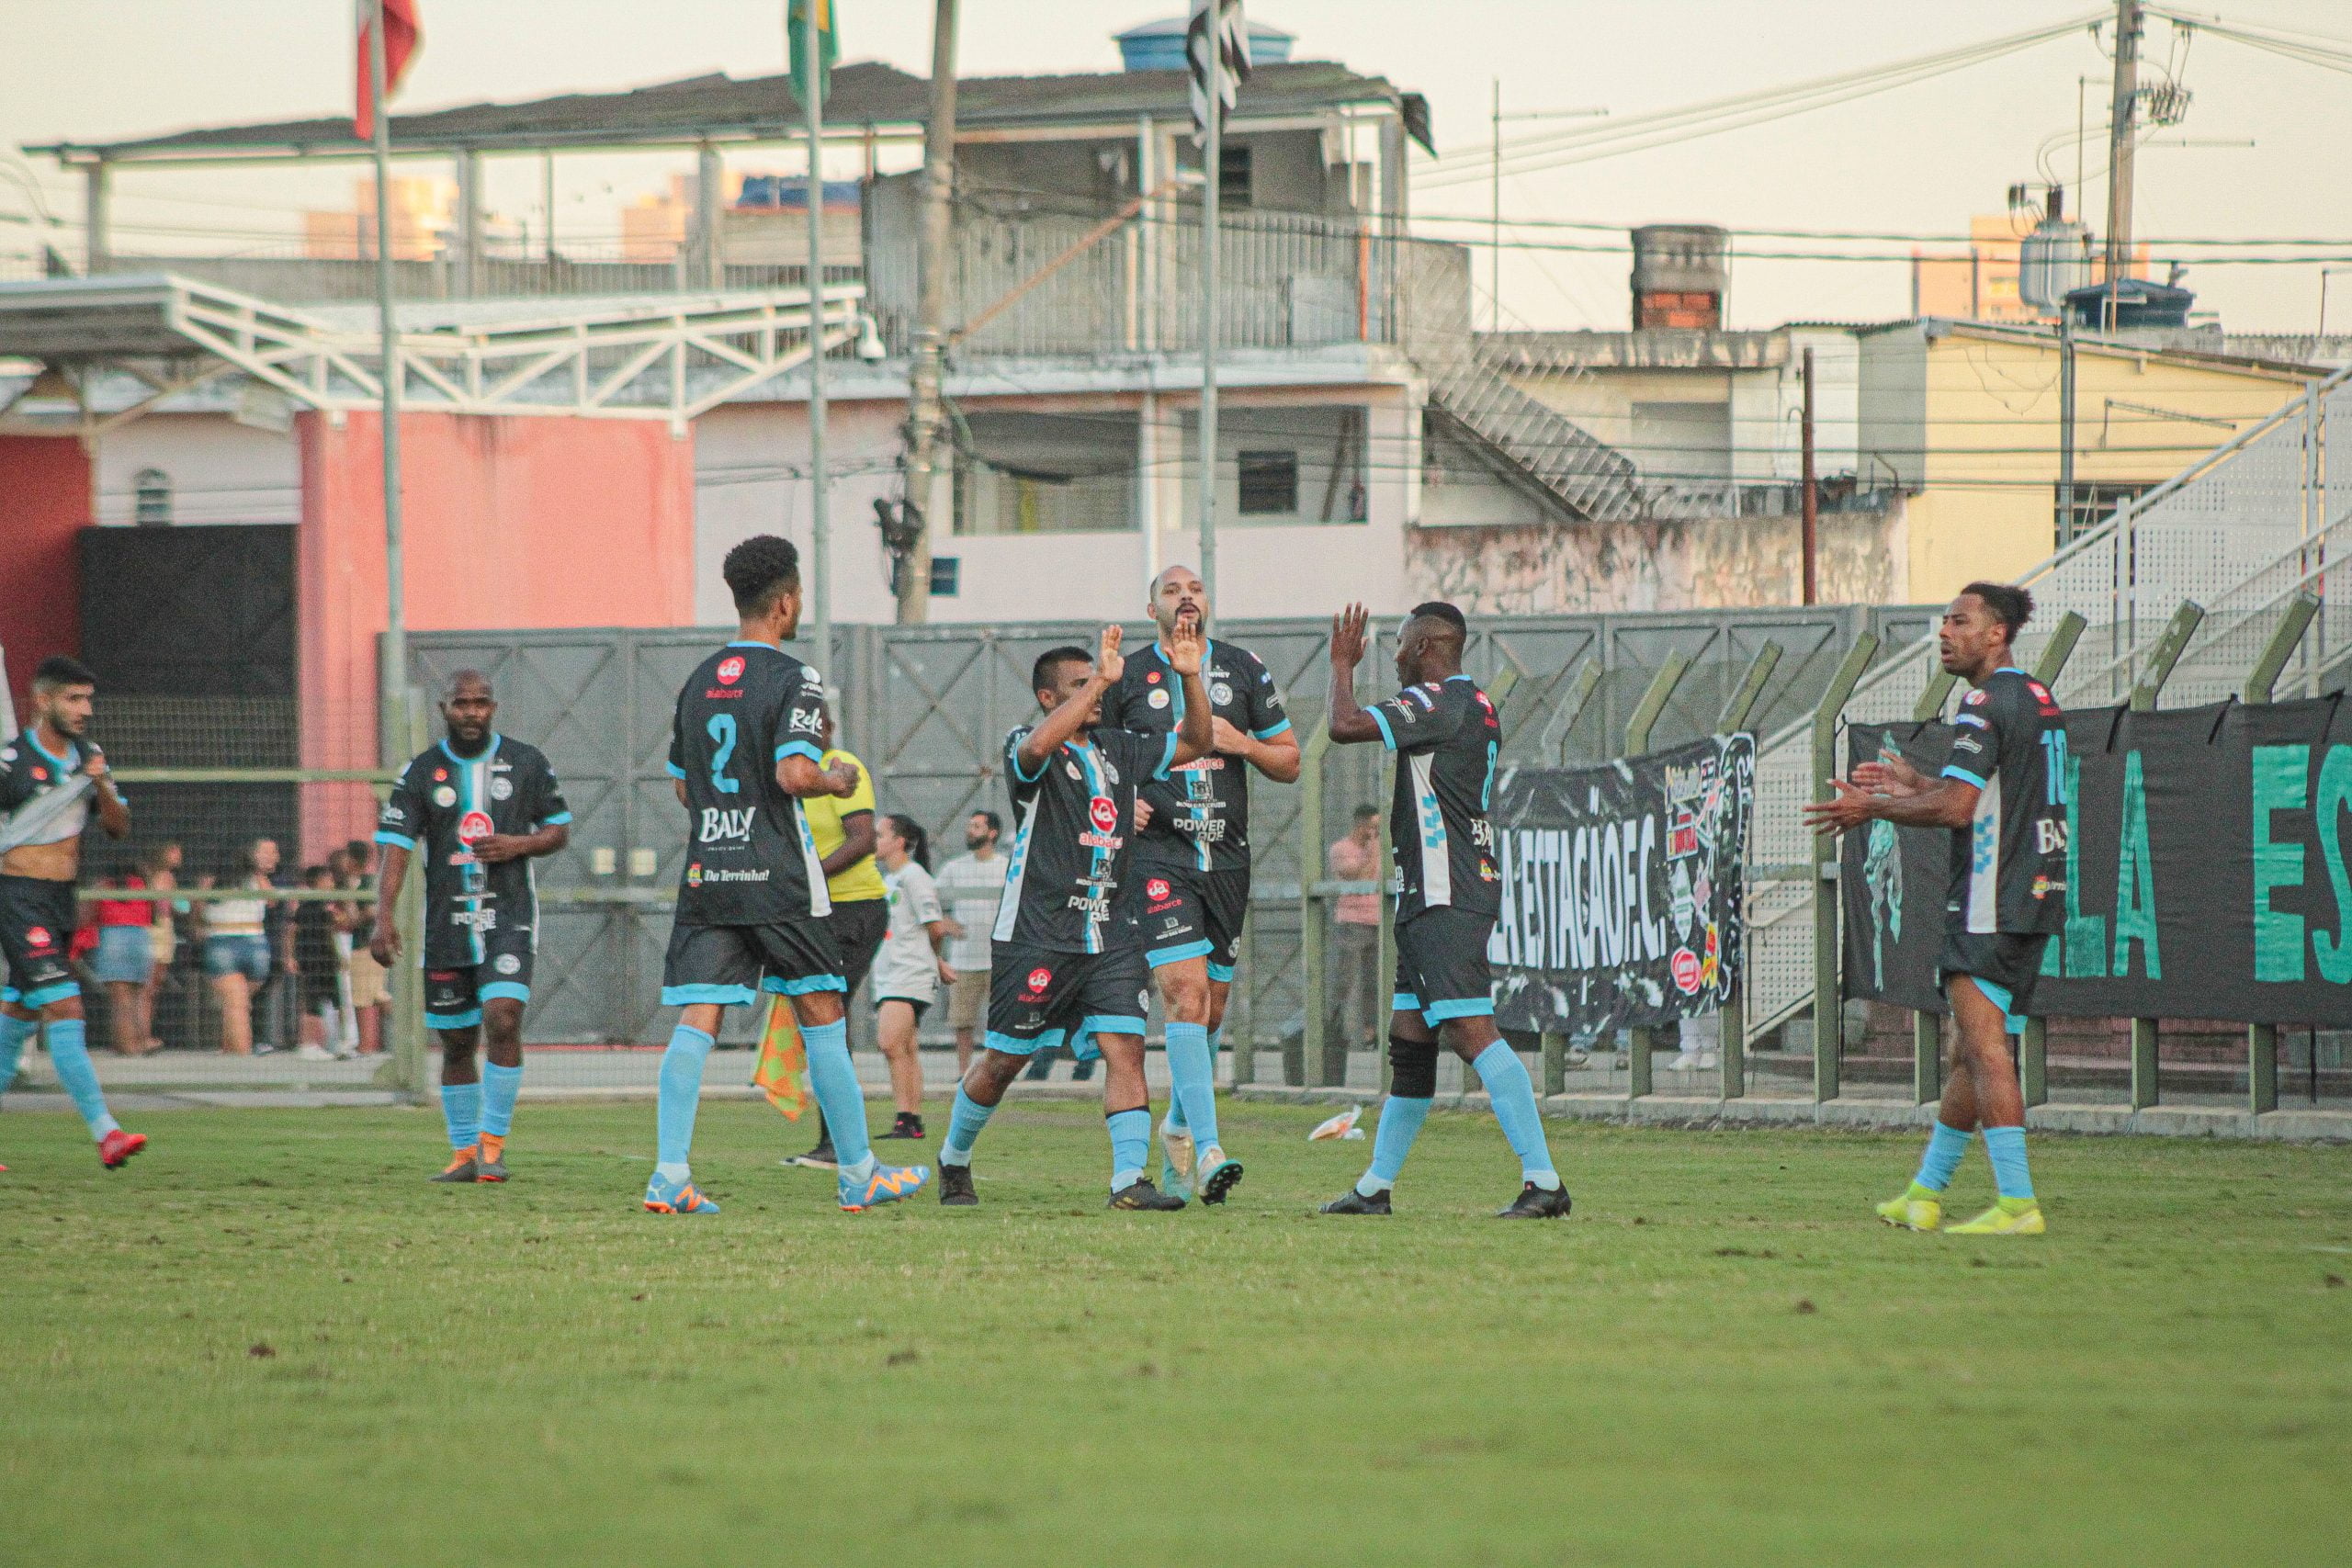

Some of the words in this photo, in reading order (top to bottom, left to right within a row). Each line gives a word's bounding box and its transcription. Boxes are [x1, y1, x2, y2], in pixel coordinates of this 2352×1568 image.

[707, 714, 739, 793] 2
[698, 807, 756, 842] BALY
[1173, 818, 1226, 831] POWER
[704, 869, 719, 882] Da
[720, 869, 770, 882] Terrinha!
[1068, 896, 1110, 912] POWE
